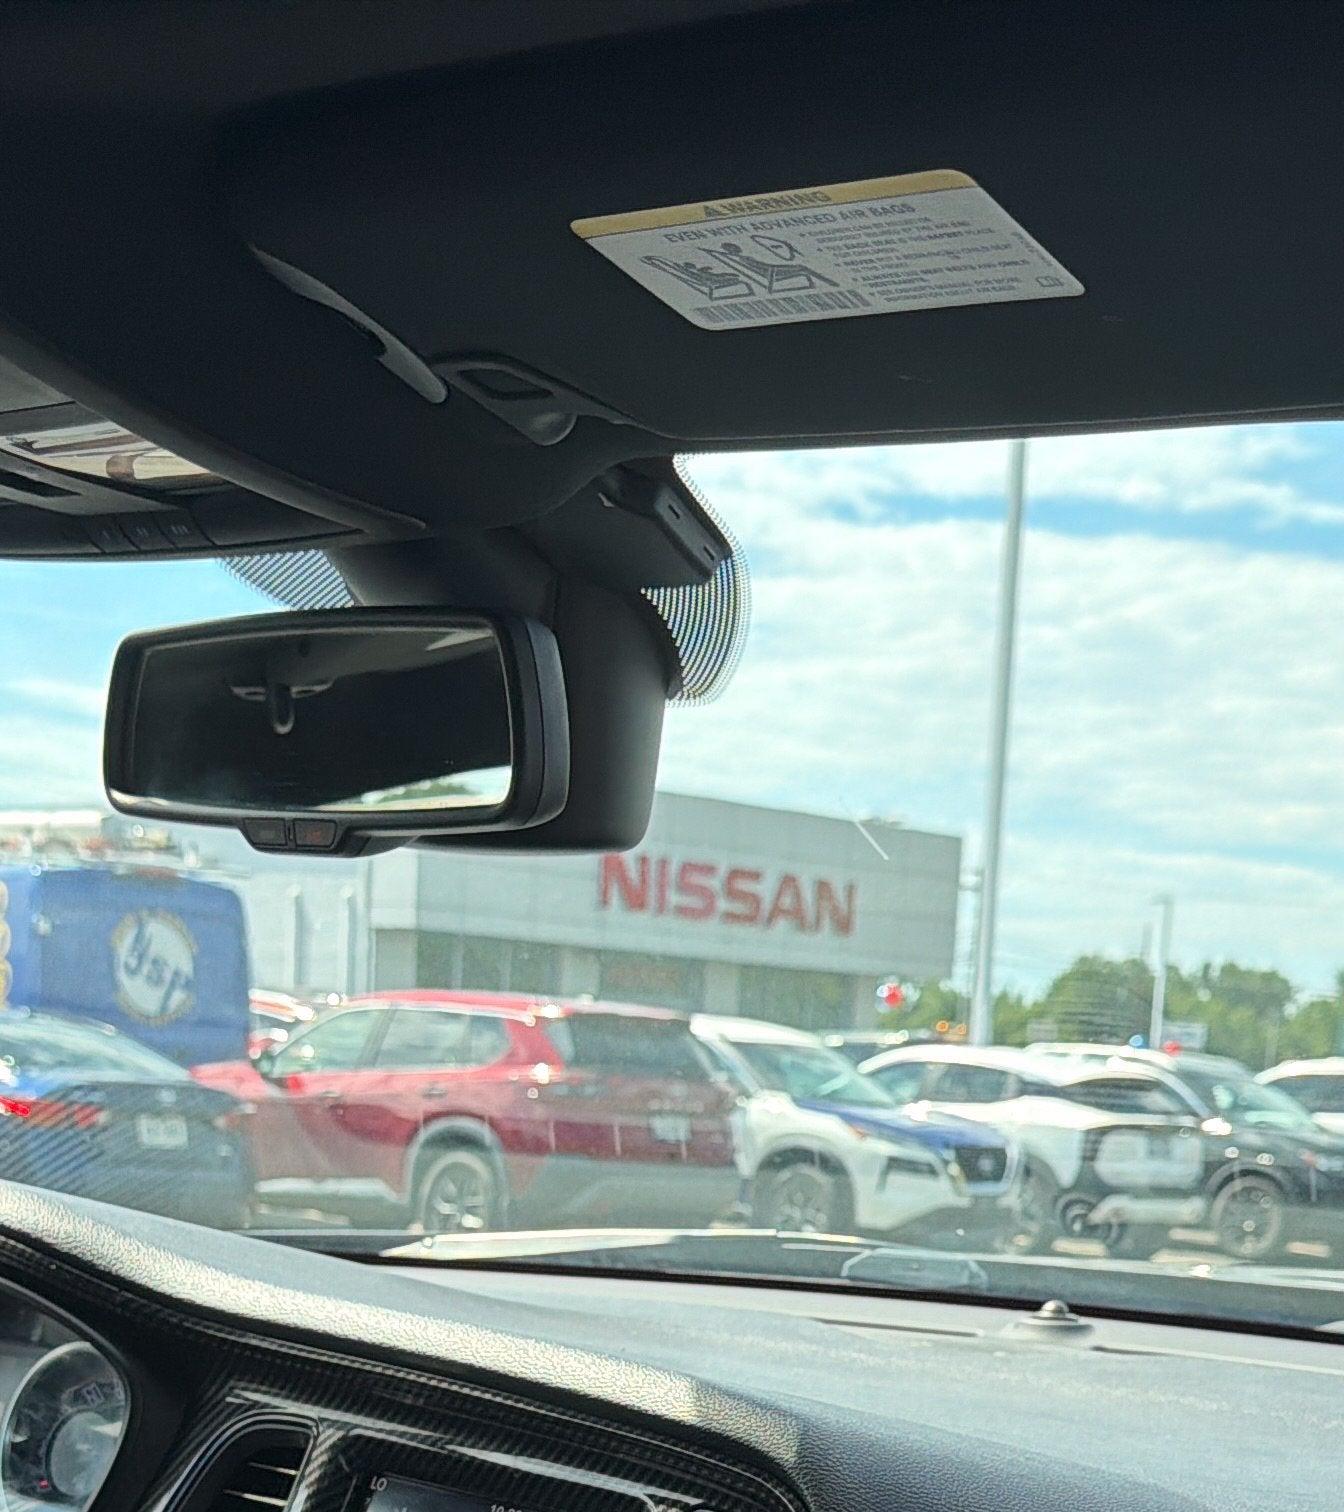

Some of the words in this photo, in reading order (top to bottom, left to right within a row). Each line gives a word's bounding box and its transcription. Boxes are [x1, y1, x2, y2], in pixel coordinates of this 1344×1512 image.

[722, 190, 831, 217] WARNING
[664, 229, 705, 244] EVEN
[706, 223, 746, 239] WITH
[750, 212, 837, 233] ADVANCED
[839, 207, 867, 221] AIR
[871, 202, 916, 217] BAGS
[599, 852, 856, 936] NISSAN
[370, 1476, 388, 1492] LO
